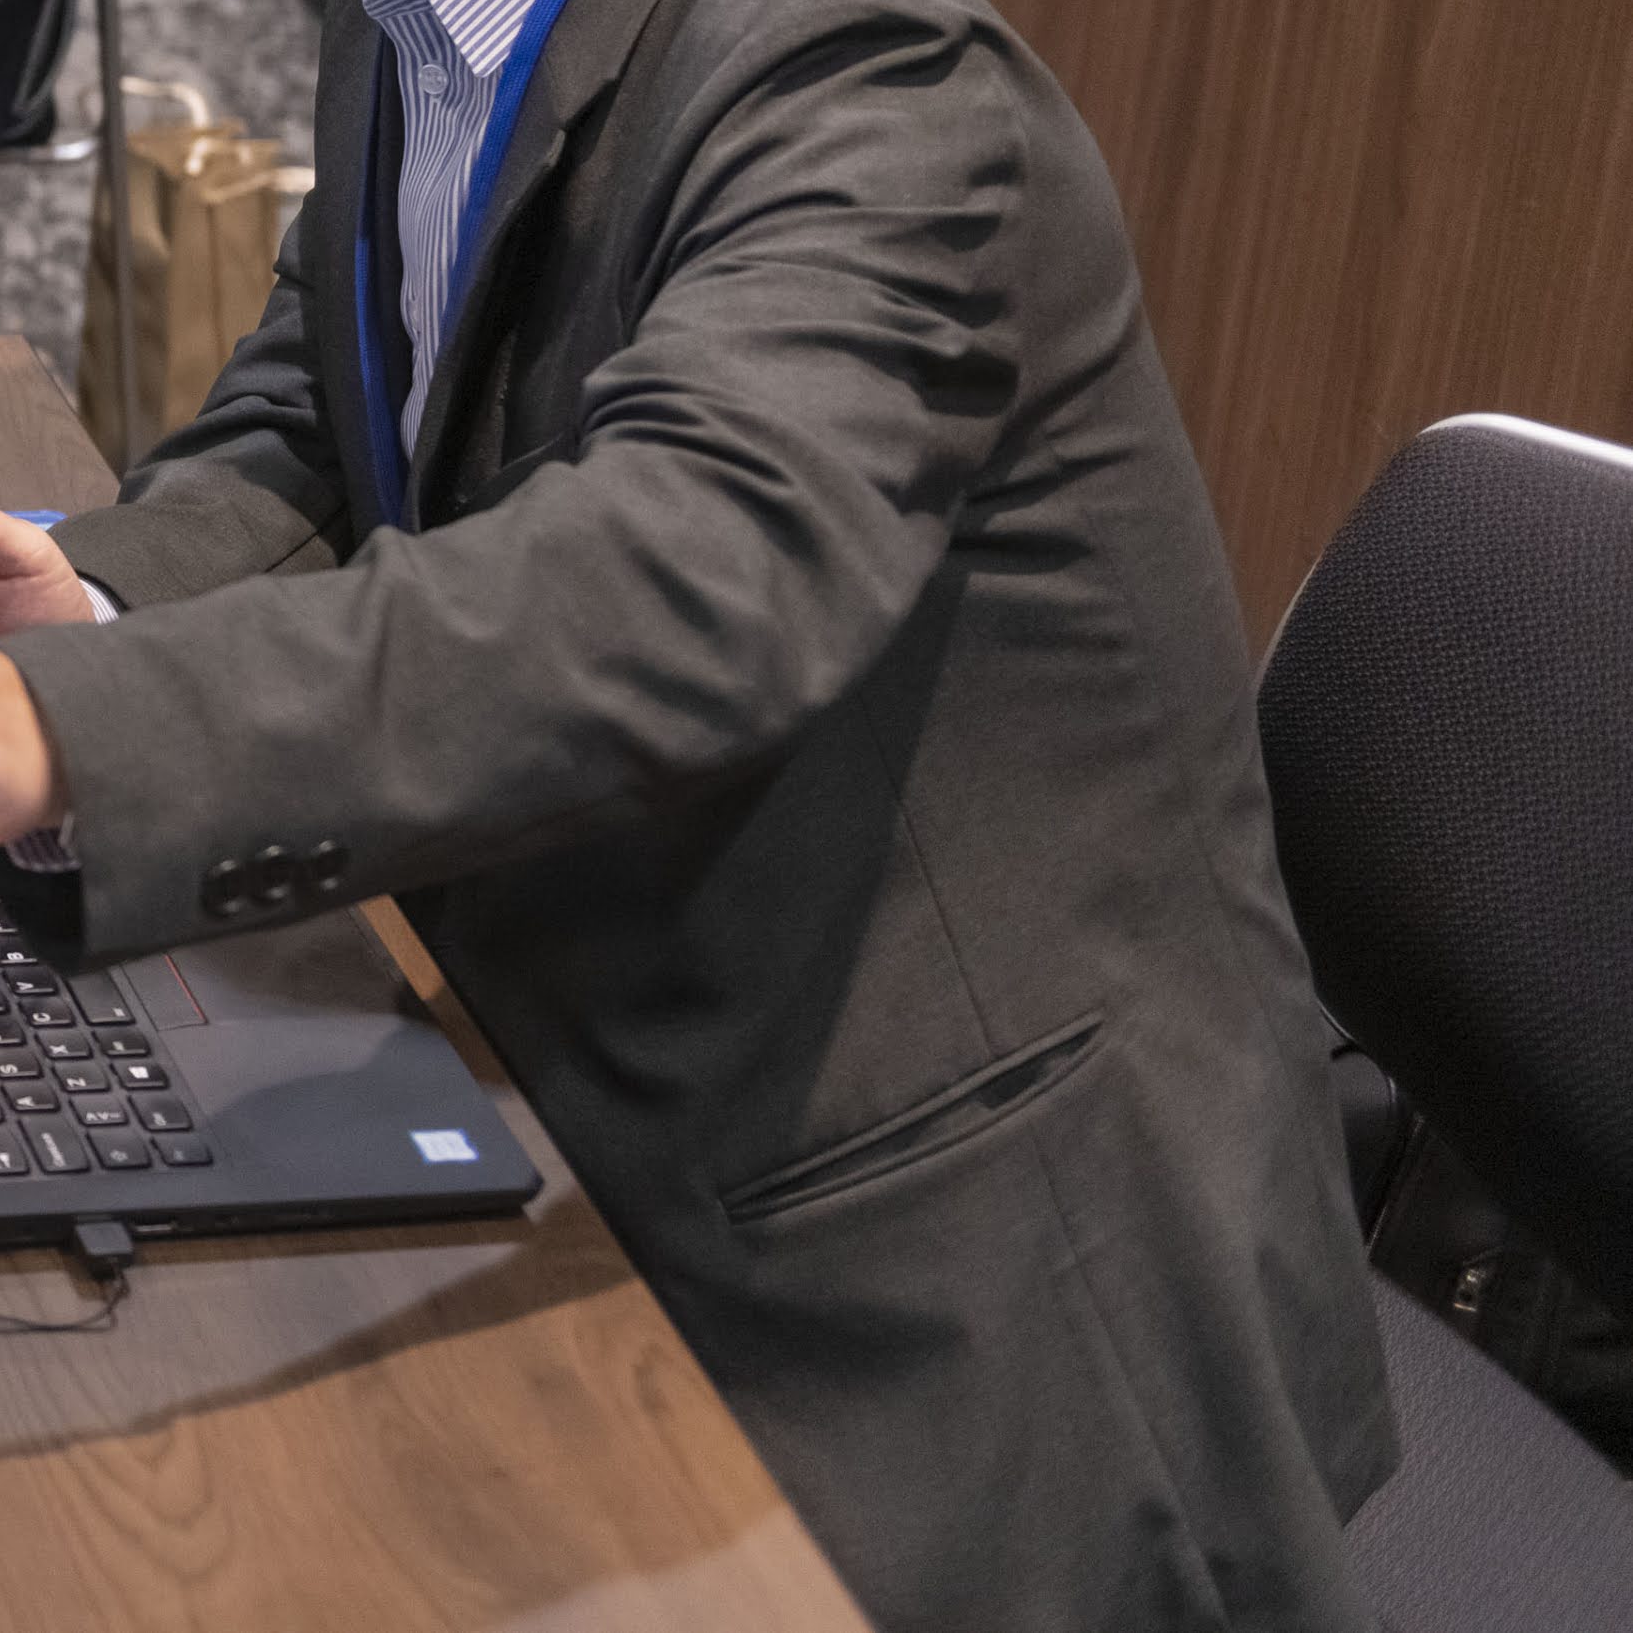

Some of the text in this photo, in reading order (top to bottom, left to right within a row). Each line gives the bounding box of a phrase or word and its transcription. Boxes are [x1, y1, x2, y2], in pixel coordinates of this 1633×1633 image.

[6, 952, 24, 960] B
[16, 981, 34, 990] V
[32, 1013, 51, 1022] C
[49, 1044, 68, 1054] X
[0, 1063, 18, 1074] S
[66, 1077, 86, 1087] Z
[16, 1096, 35, 1107] A
